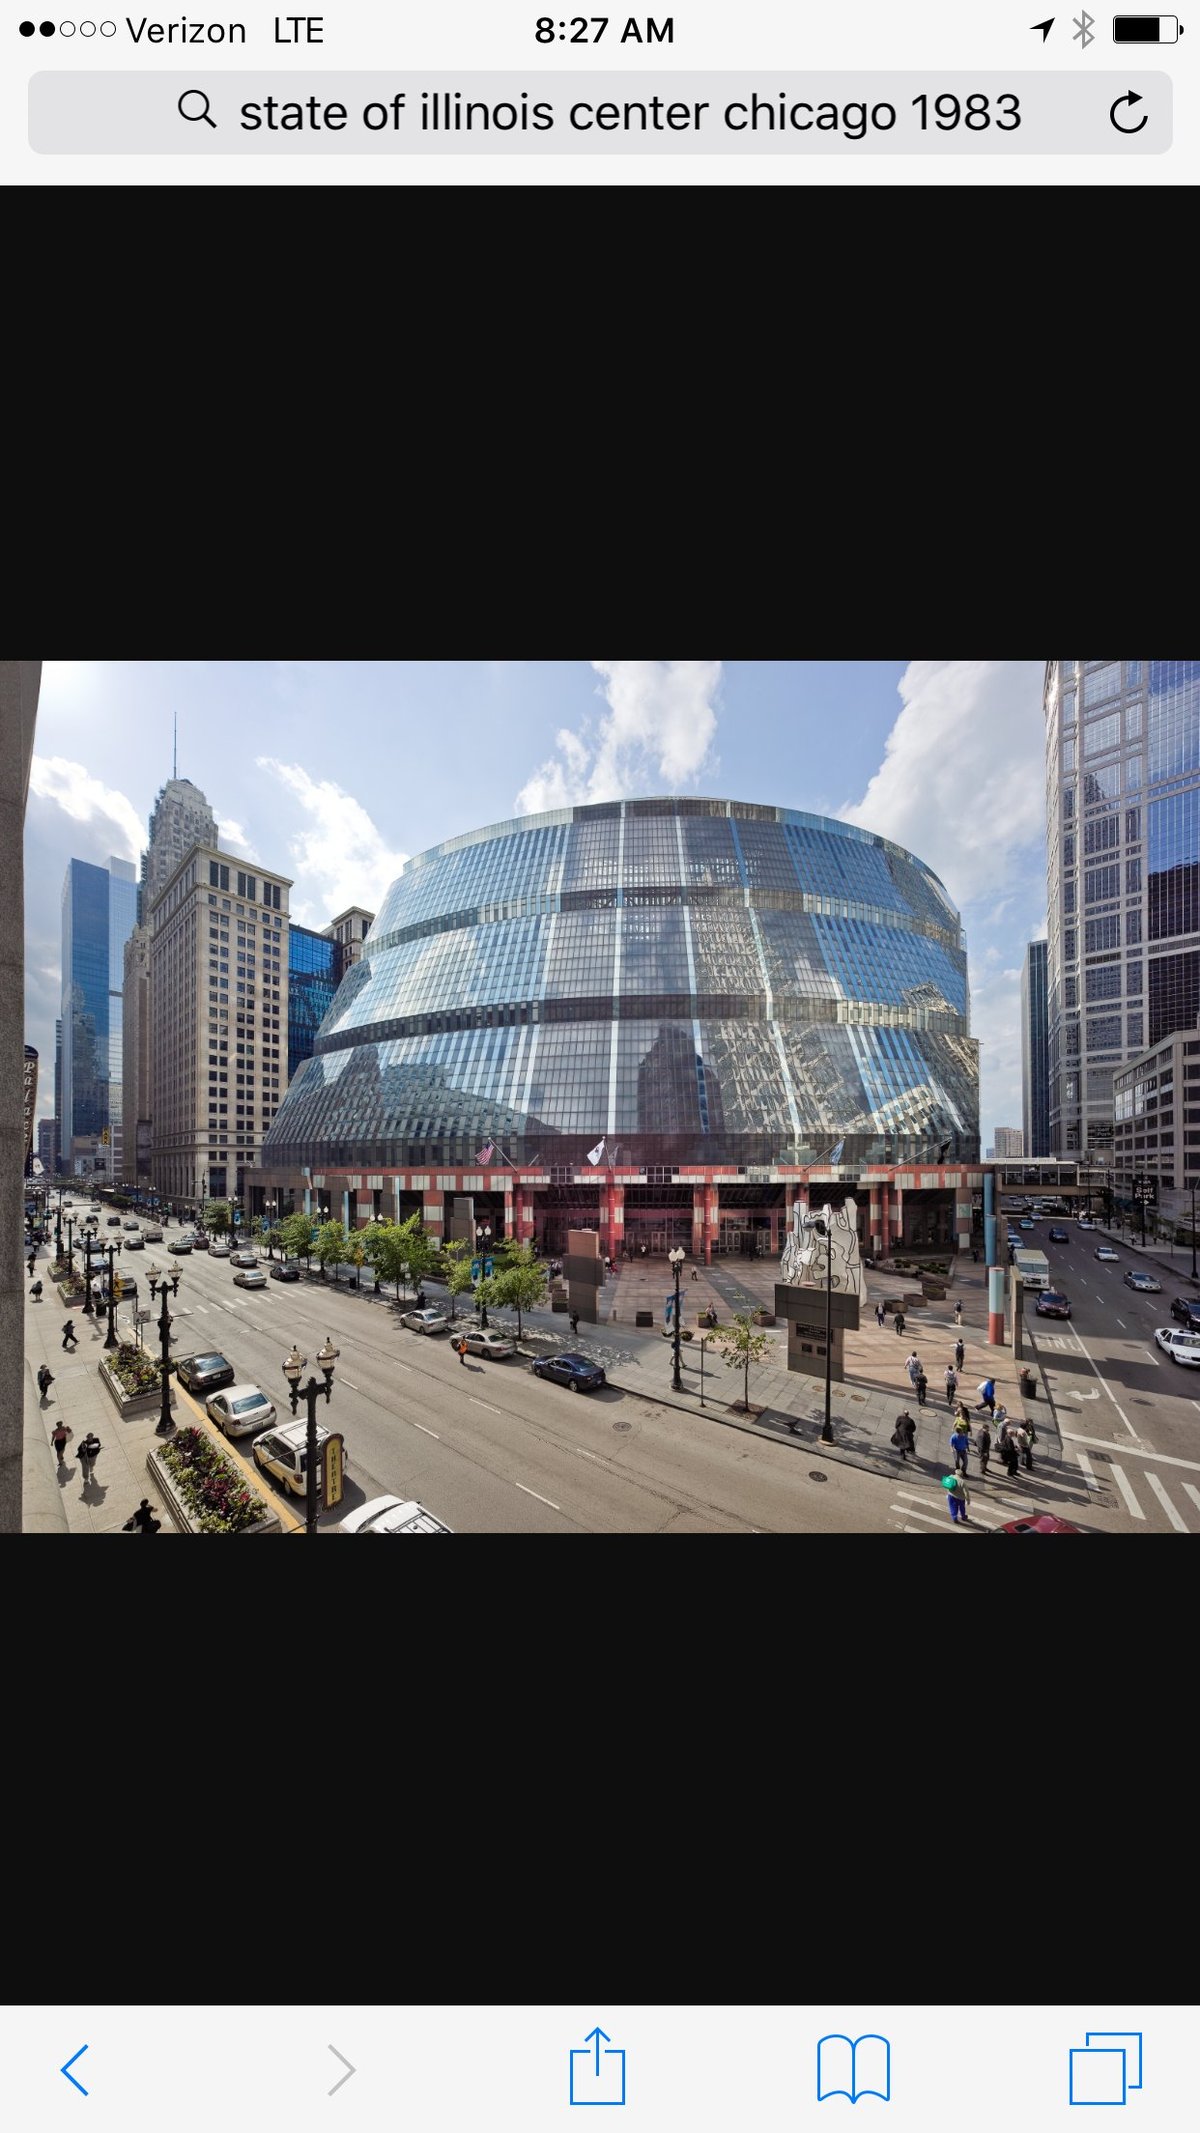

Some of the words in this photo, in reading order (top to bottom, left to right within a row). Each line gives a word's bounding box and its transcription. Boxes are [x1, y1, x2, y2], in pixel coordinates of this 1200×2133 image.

[125, 16, 247, 44] Verizon
[274, 17, 324, 43] LTE
[535, 16, 609, 44] 8:27
[620, 17, 675, 43] AM
[240, 96, 348, 131] state
[362, 93, 407, 131] of
[420, 92, 554, 131] illinois
[569, 96, 710, 131] center
[724, 92, 898, 140] chicago
[911, 93, 1022, 131] 1983
[1135, 1186, 1154, 1194] Self
